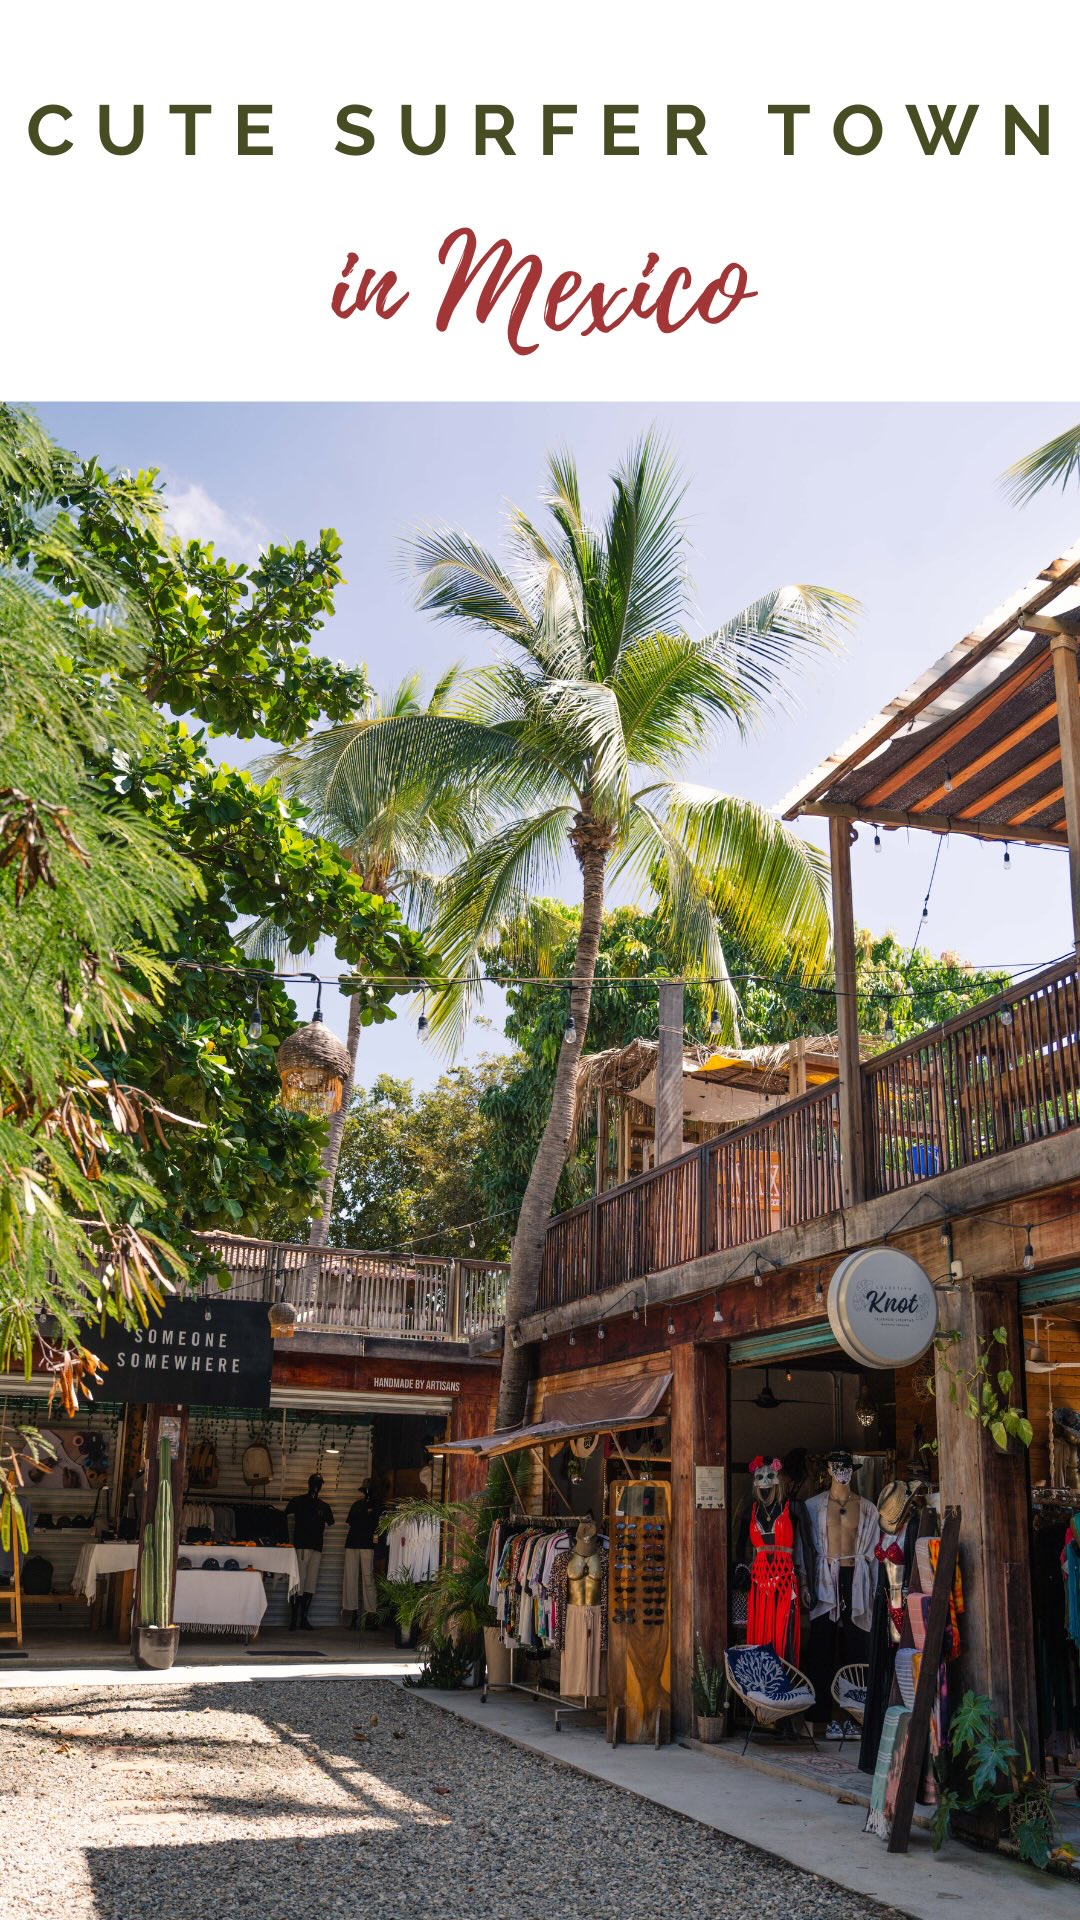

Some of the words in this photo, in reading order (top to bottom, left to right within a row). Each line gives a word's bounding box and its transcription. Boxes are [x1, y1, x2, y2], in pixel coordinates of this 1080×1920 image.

[866, 1290, 919, 1314] Knot
[134, 1328, 228, 1348] SOMEONE
[117, 1352, 240, 1374] SOMEWHERE
[373, 1377, 413, 1389] HANDMADE
[415, 1379, 424, 1390] BY
[426, 1380, 460, 1392] ARTISANS
